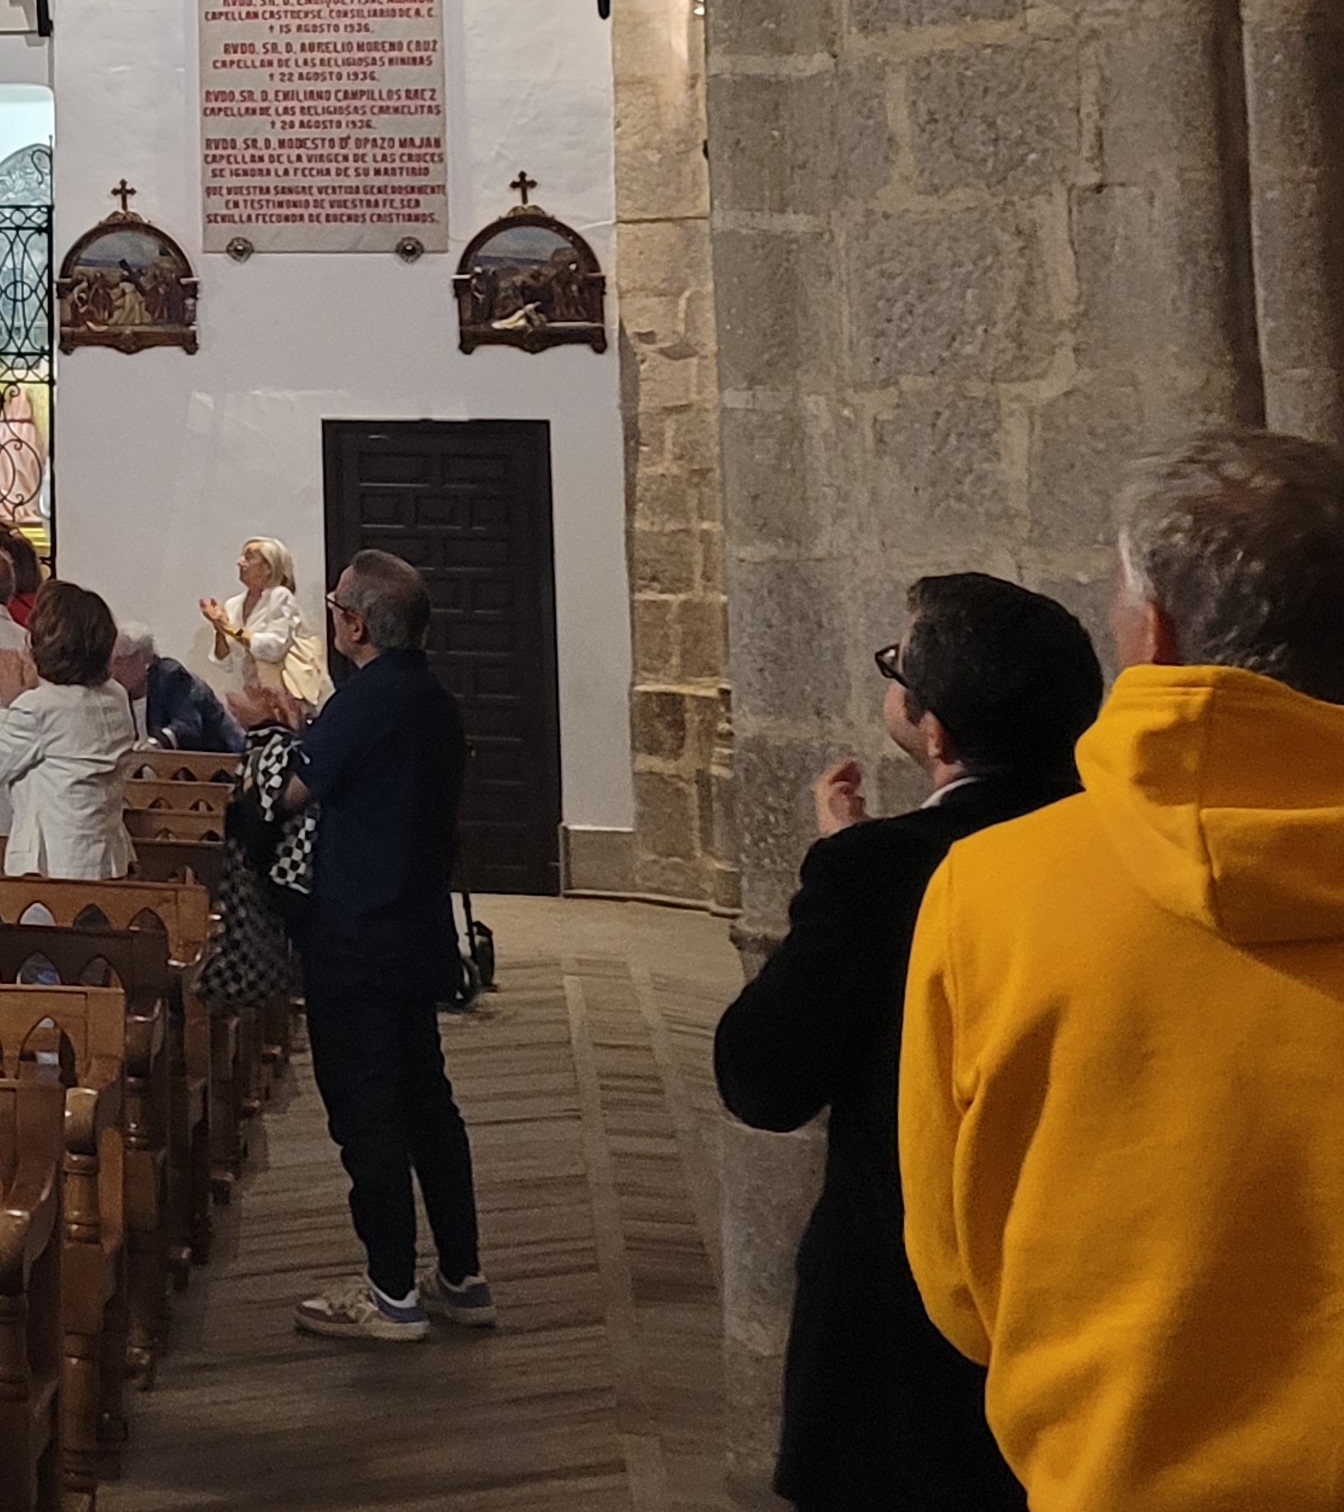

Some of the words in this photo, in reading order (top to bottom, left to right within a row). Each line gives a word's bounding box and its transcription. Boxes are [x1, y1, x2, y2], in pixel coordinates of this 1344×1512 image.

[204, 11, 259, 22] CAPELLAN
[296, 23, 339, 34] AGOSTO
[300, 41, 353, 55] AURELIO
[357, 40, 403, 54] MORENO
[213, 58, 274, 70] CAPELLAN
[277, 58, 290, 69] DE
[295, 58, 316, 68] LAS
[279, 72, 294, 83] 22
[298, 71, 342, 82] AGOSTO
[274, 89, 331, 102] EMILIANO
[334, 88, 401, 102] CAMPILLOS
[404, 87, 436, 101] RAEZ
[275, 106, 296, 116] LAS
[299, 105, 367, 116] RELIGIOSAS
[299, 119, 342, 130] AGOSTO
[278, 138, 335, 150] MODESTO
[355, 137, 395, 150] OPAZO
[204, 153, 265, 165] CAPELLAN
[306, 153, 350, 164] VIRGEN
[353, 152, 368, 163] DE
[373, 152, 395, 163] LAS
[399, 152, 444, 163] CRUCES
[211, 168, 226, 178] SE
[230, 168, 271, 178] IGNORA
[274, 168, 290, 178] LA
[293, 168, 332, 178] FECHA
[335, 167, 351, 178] DE
[354, 167, 370, 178] SU
[373, 167, 430, 177] MARTIRIO
[243, 199, 310, 210] TESTIMONIO
